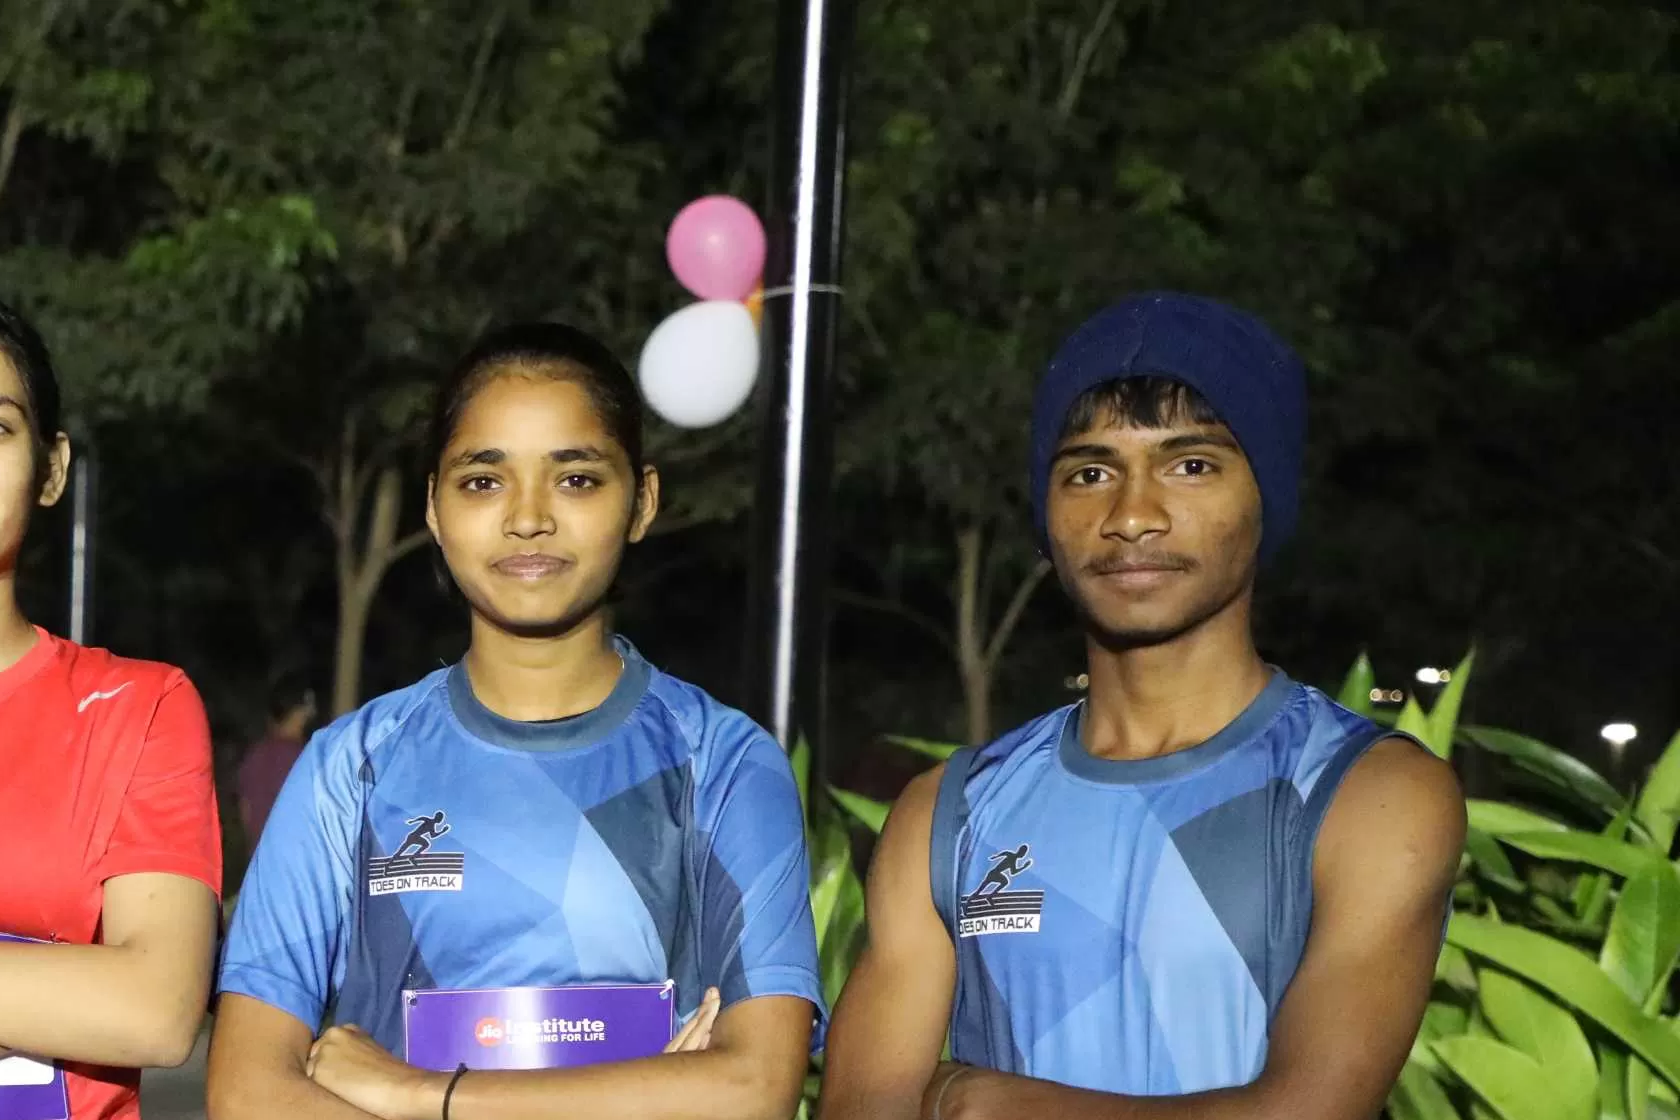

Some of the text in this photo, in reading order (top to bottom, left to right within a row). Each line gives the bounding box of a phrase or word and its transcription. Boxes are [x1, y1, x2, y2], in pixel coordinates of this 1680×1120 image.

[370, 876, 457, 892] TOES ON TRACK
[975, 919, 988, 932] ON
[991, 916, 1034, 930] TRACK
[478, 1024, 503, 1038] Jio
[560, 1032, 582, 1042] FOR
[584, 1032, 605, 1041] LIFE
